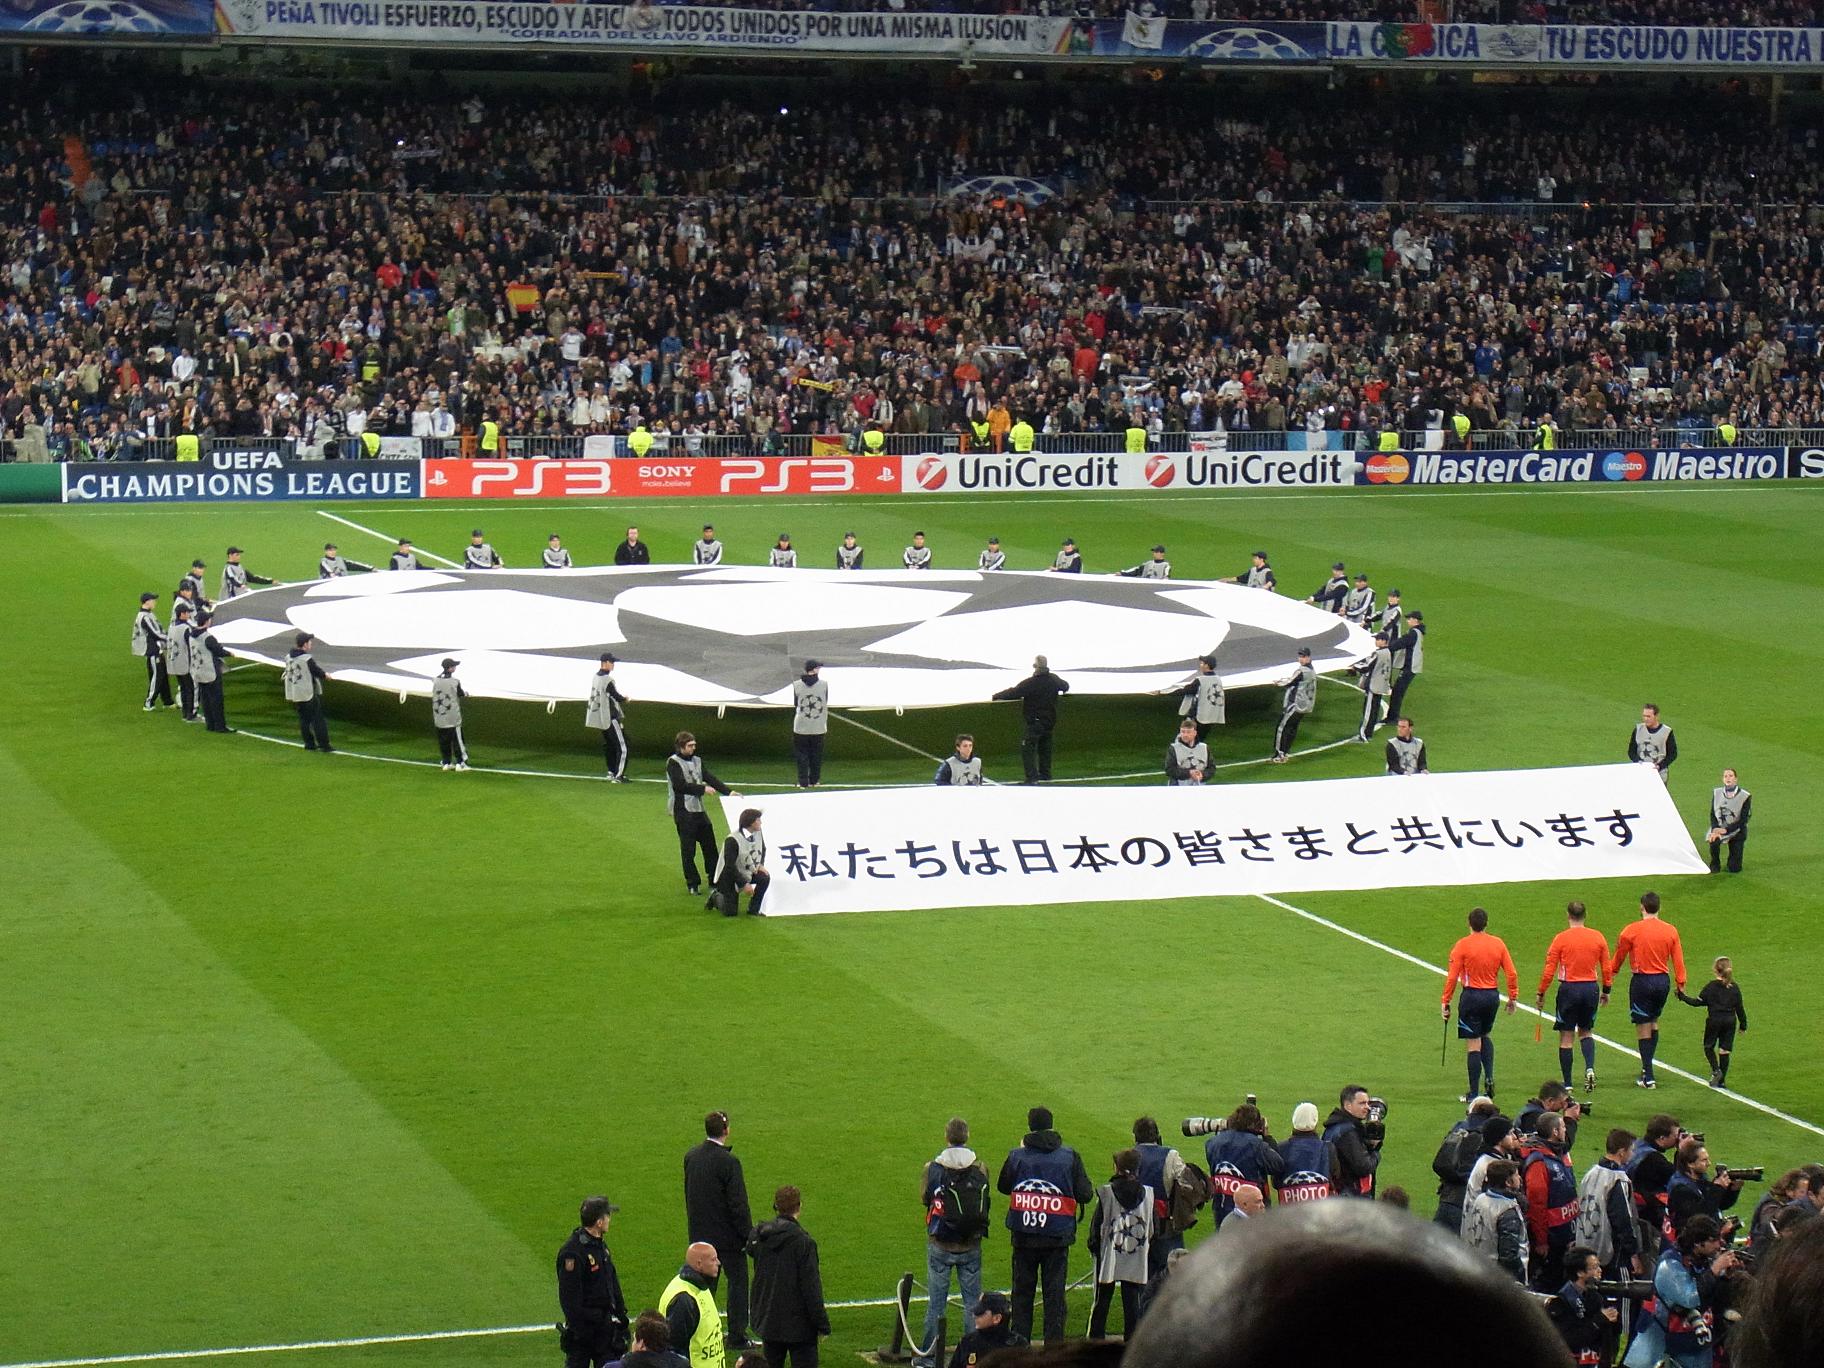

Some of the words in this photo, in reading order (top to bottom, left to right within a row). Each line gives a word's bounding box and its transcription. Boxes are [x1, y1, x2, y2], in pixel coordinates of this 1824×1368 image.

[266, 1, 316, 25] PEÑA
[320, 3, 379, 26] TIVOLI
[385, 4, 482, 32] ESFUERZO,
[487, 6, 560, 30] ESCUDO
[563, 8, 577, 29] Y
[664, 9, 725, 33] TODOS
[730, 11, 801, 36] UNIDOS
[806, 15, 843, 37] POR
[849, 16, 888, 38] UNA
[891, 17, 953, 39] MISMA
[959, 18, 1028, 41] ILUSION
[607, 31, 638, 40] DEL
[1328, 24, 1363, 57] LA
[1546, 27, 1577, 59] TU
[1584, 27, 1689, 61] ESCUDO
[1696, 29, 1812, 62] NUESTRA
[212, 451, 283, 469] UEFA
[638, 465, 697, 478] SONY
[958, 456, 1119, 489] UniCredit
[1186, 453, 1342, 485] UniCredit
[1412, 453, 1595, 484] MasterCard
[1607, 462, 1642, 472] Maestro
[1651, 451, 1778, 481] Maestro
[76, 472, 274, 499] CHAMPIONS
[288, 472, 412, 495] LEAGUE
[471, 461, 611, 495] PS3
[720, 459, 855, 493] PS3
[776, 808, 1641, 882] 私たちは日本の皆さまと共にいます
[1014, 1195, 1063, 1212] PHOTO
[1284, 1186, 1328, 1204] PHOTO
[1022, 1210, 1047, 1228] 039
